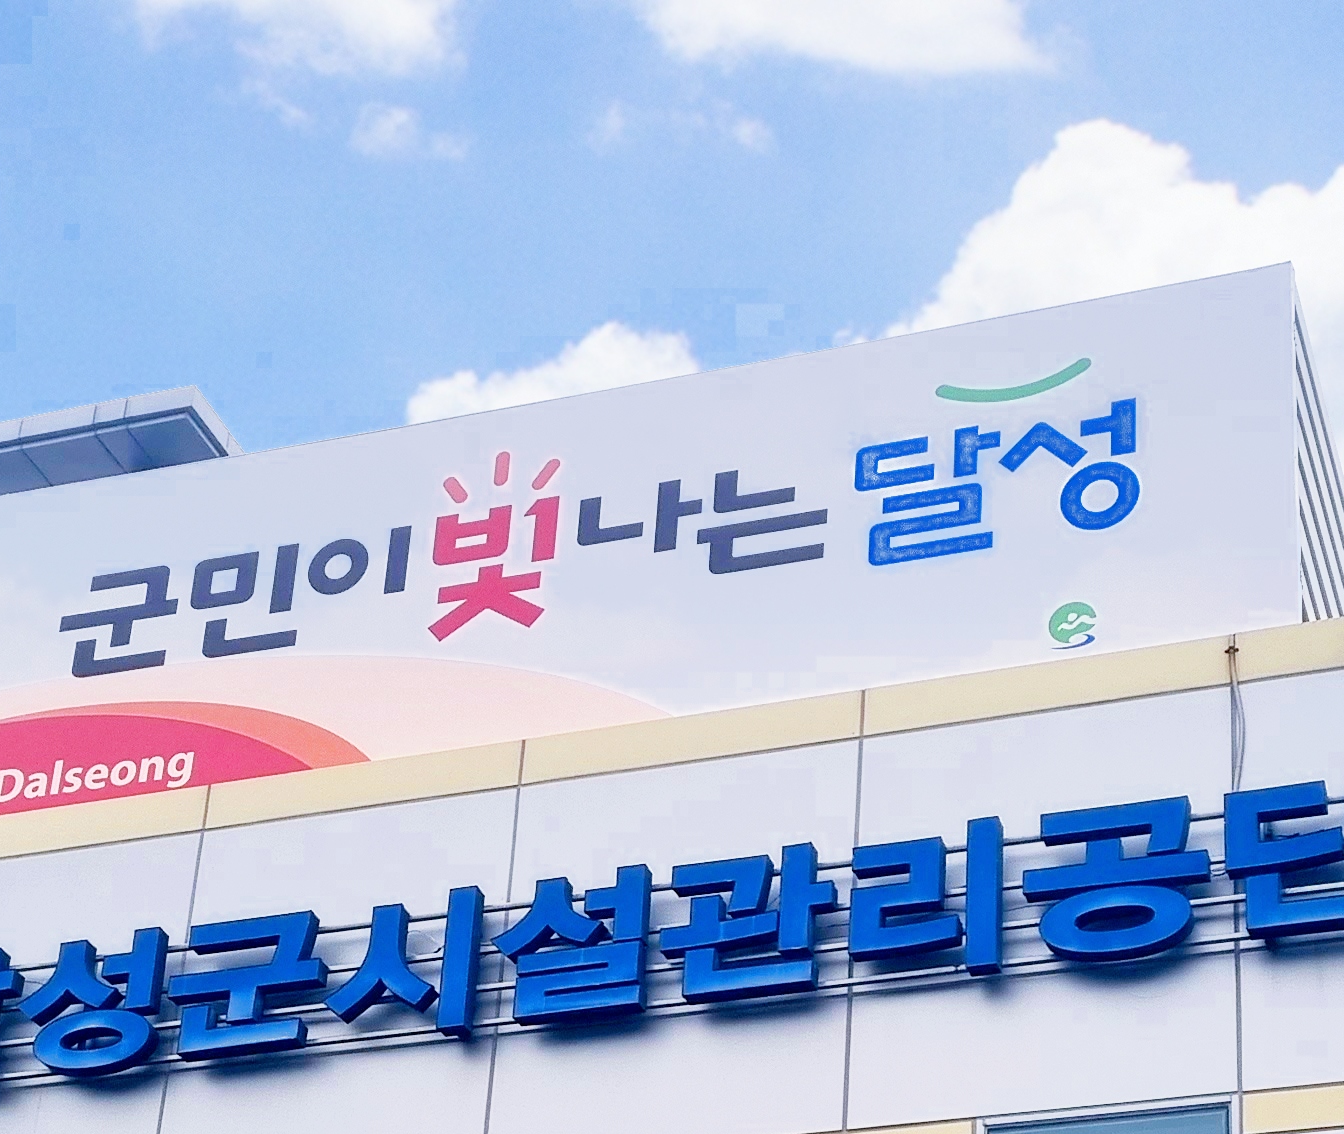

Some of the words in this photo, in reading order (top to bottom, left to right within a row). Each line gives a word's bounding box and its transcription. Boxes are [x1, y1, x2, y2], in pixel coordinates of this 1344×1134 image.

[58, 524, 412, 678] 군민이
[427, 450, 829, 642] 빛나는
[853, 396, 1141, 567] 달성
